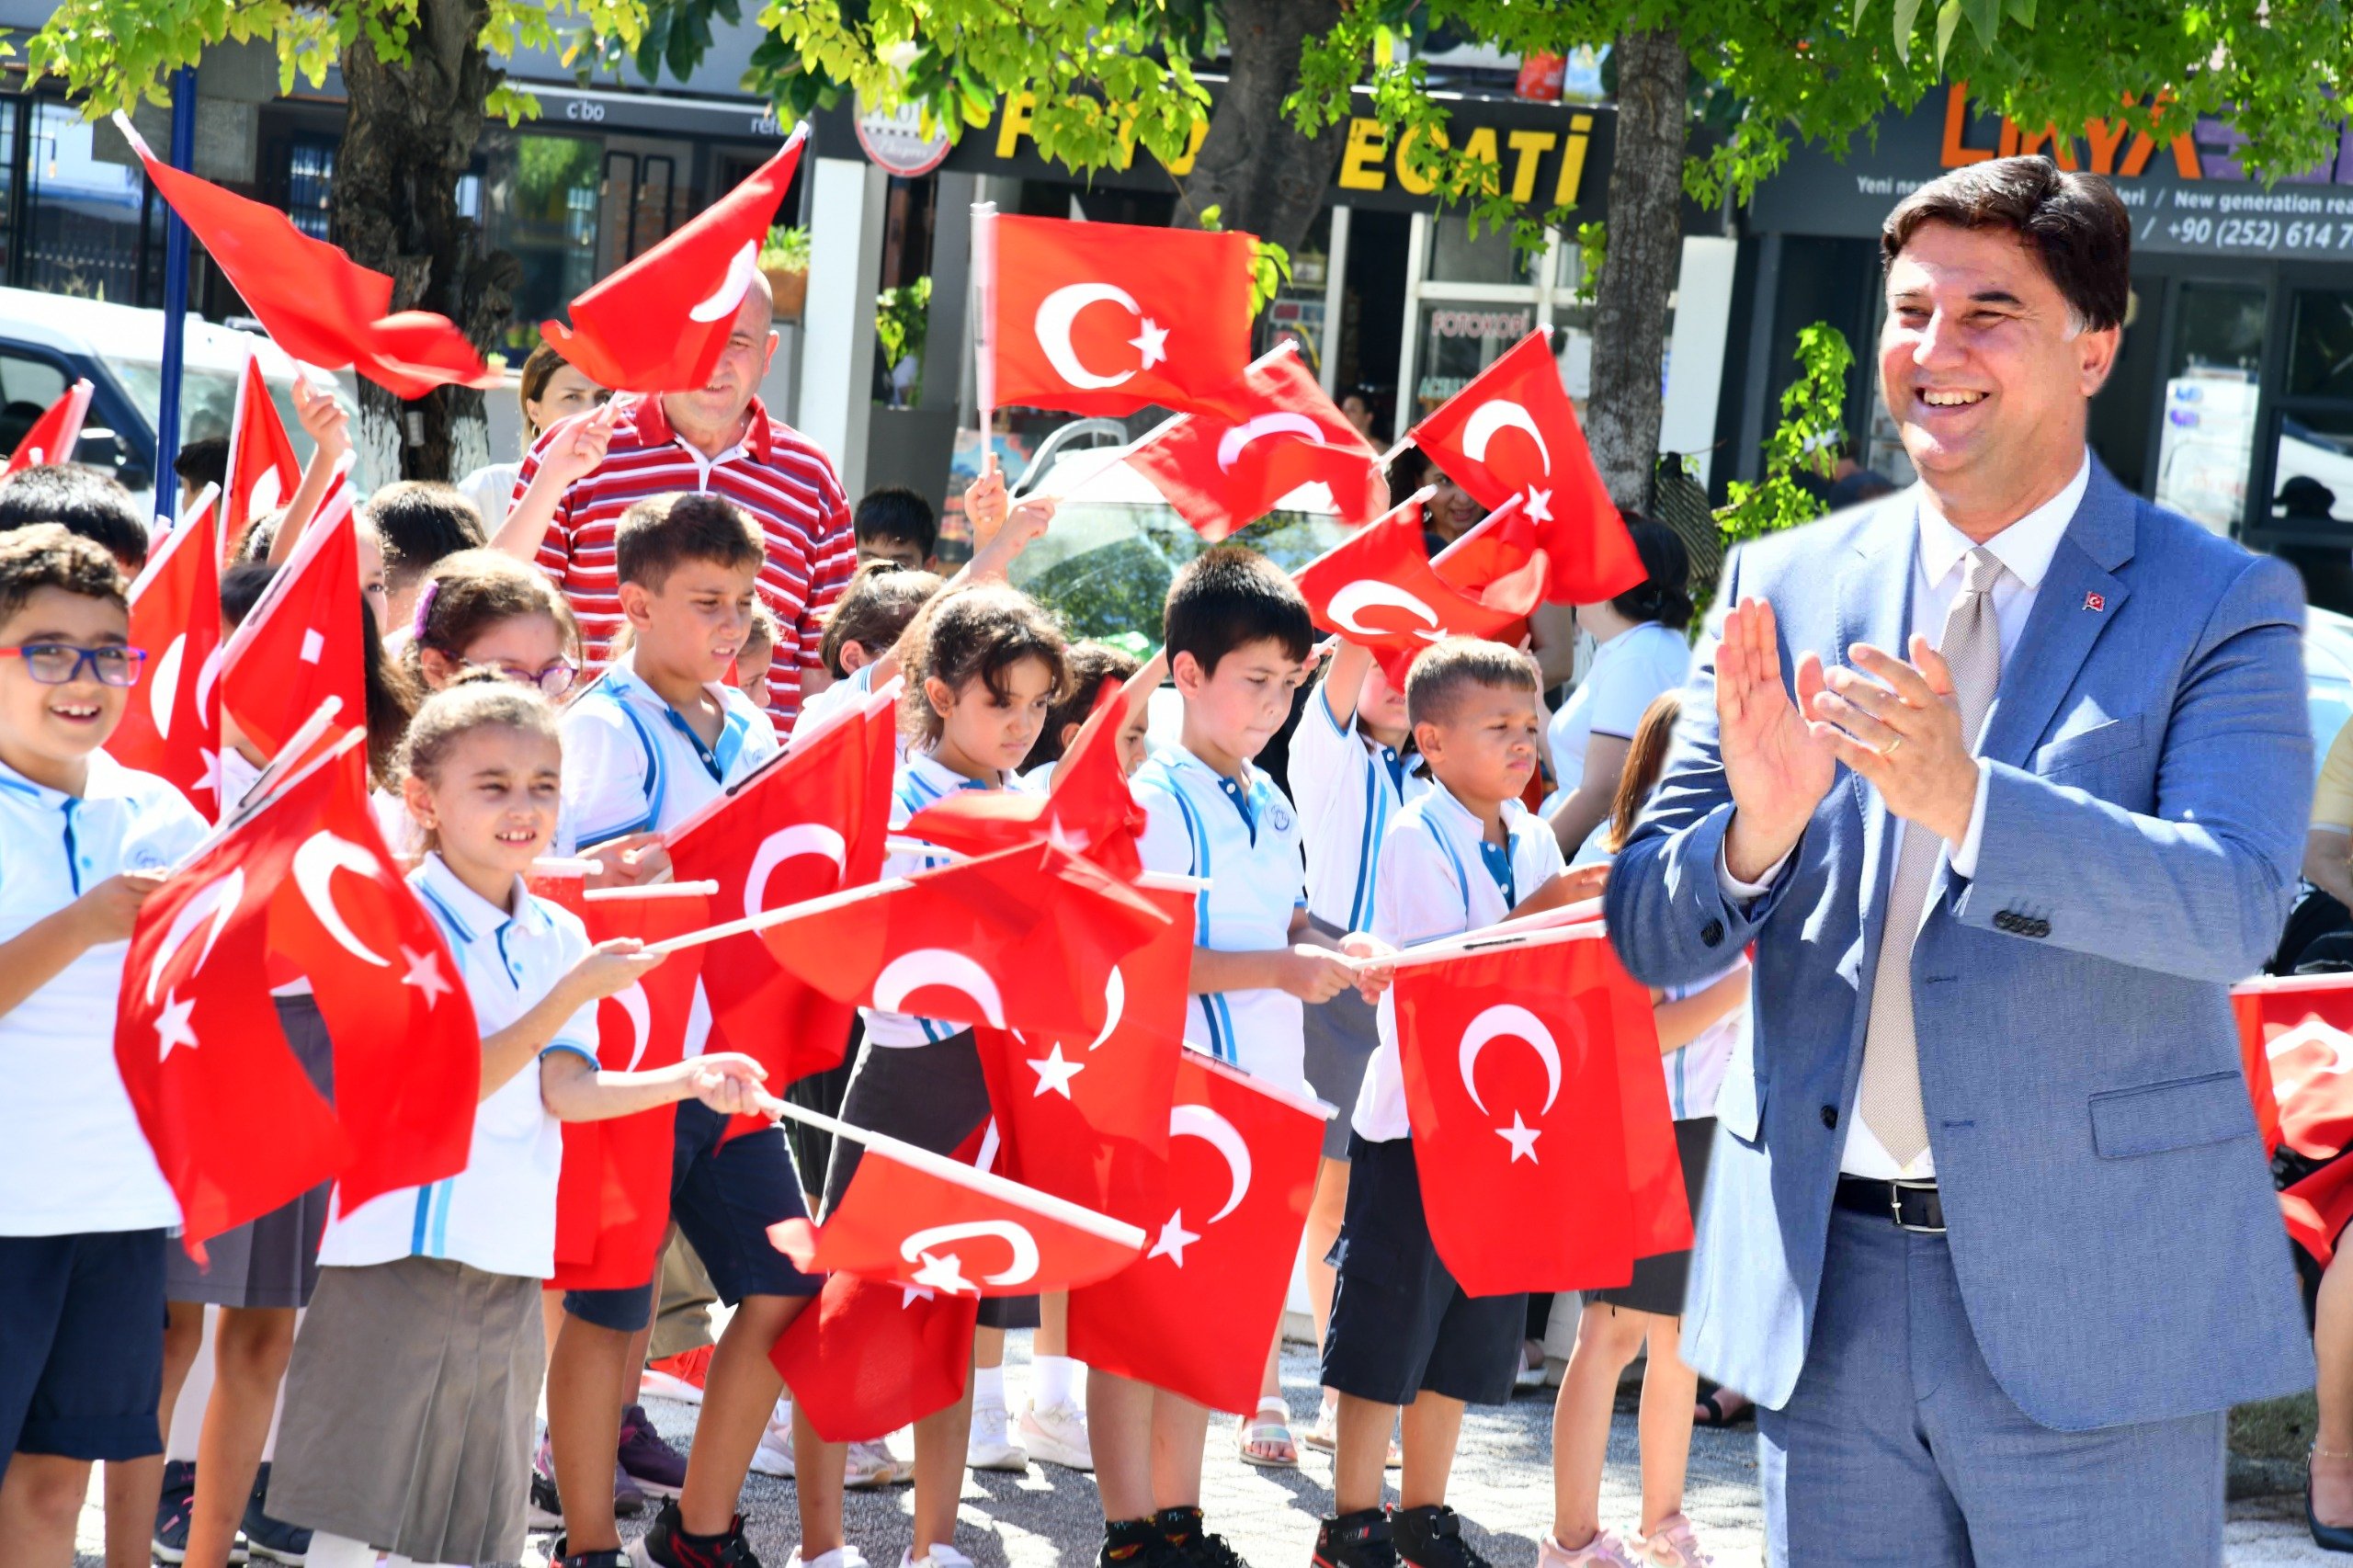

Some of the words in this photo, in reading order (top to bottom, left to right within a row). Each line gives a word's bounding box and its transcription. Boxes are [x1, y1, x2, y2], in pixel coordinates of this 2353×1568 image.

[1857, 175, 1893, 195] Yeni
[1895, 179, 1927, 195] ne
[2175, 188, 2214, 210] New
[2219, 193, 2323, 213] generation
[2167, 216, 2212, 244] +90
[2216, 218, 2280, 252] (252)
[2285, 221, 2333, 249] 614
